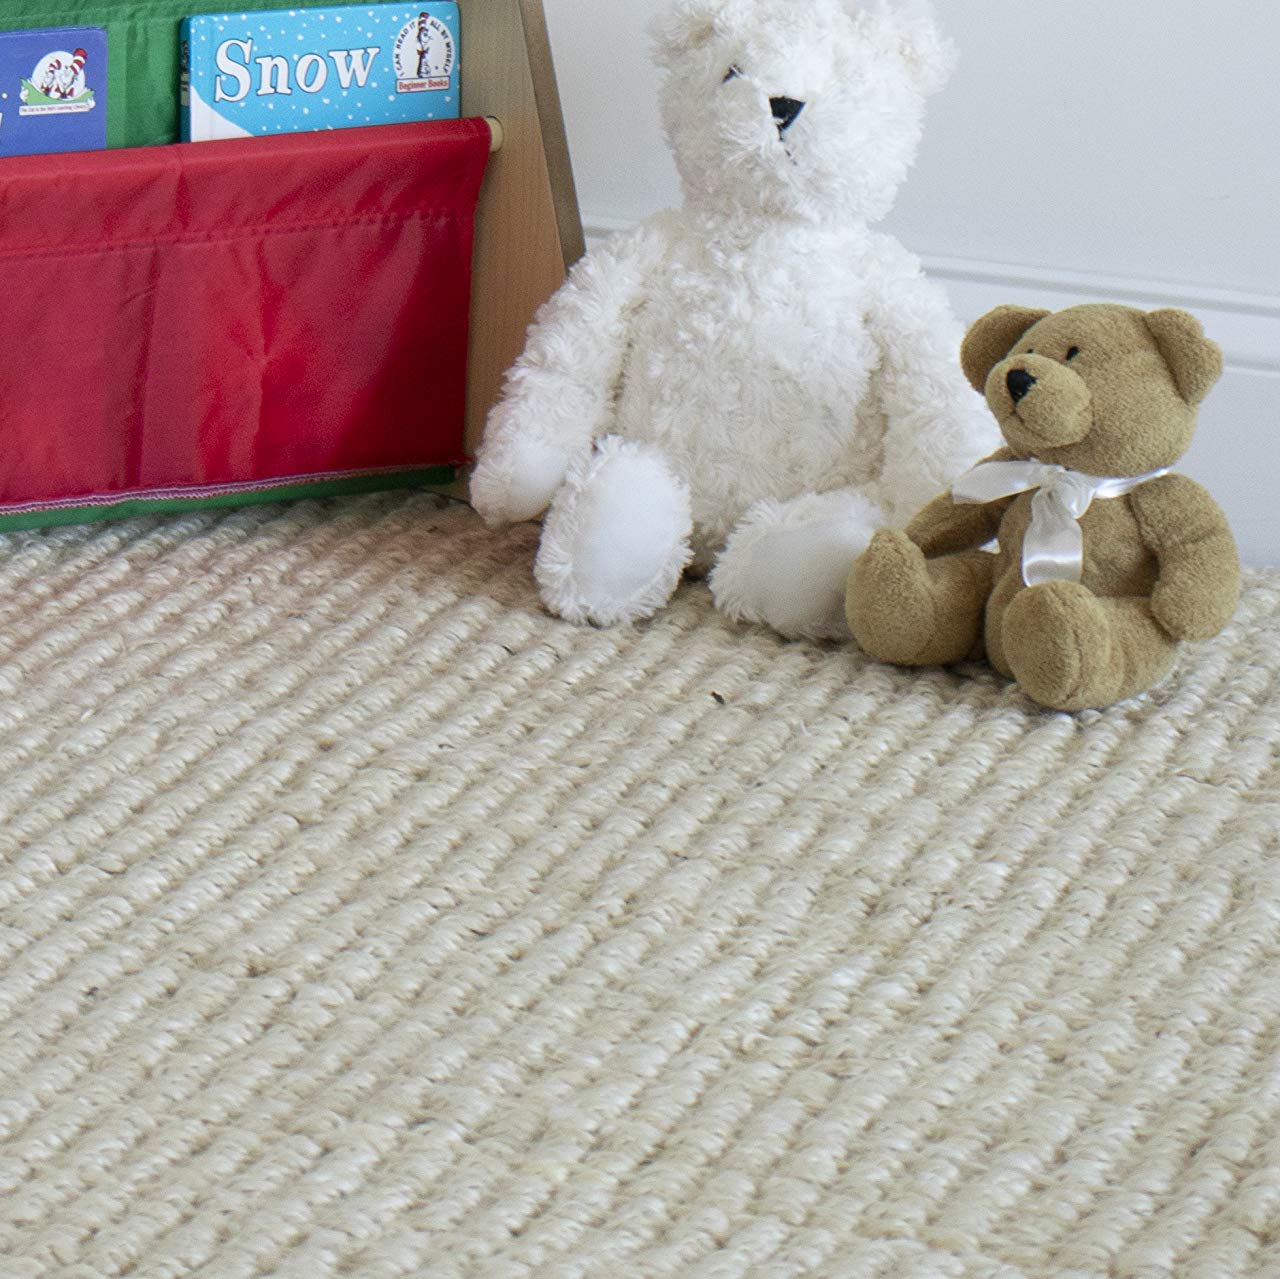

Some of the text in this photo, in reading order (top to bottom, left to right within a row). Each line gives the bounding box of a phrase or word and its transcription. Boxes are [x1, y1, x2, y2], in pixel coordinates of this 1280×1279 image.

[396, 28, 409, 50] READ
[394, 53, 403, 71] CAN
[443, 42, 452, 73] MYSELF
[214, 38, 380, 102] Snow
[399, 79, 448, 91] Beginner Books
